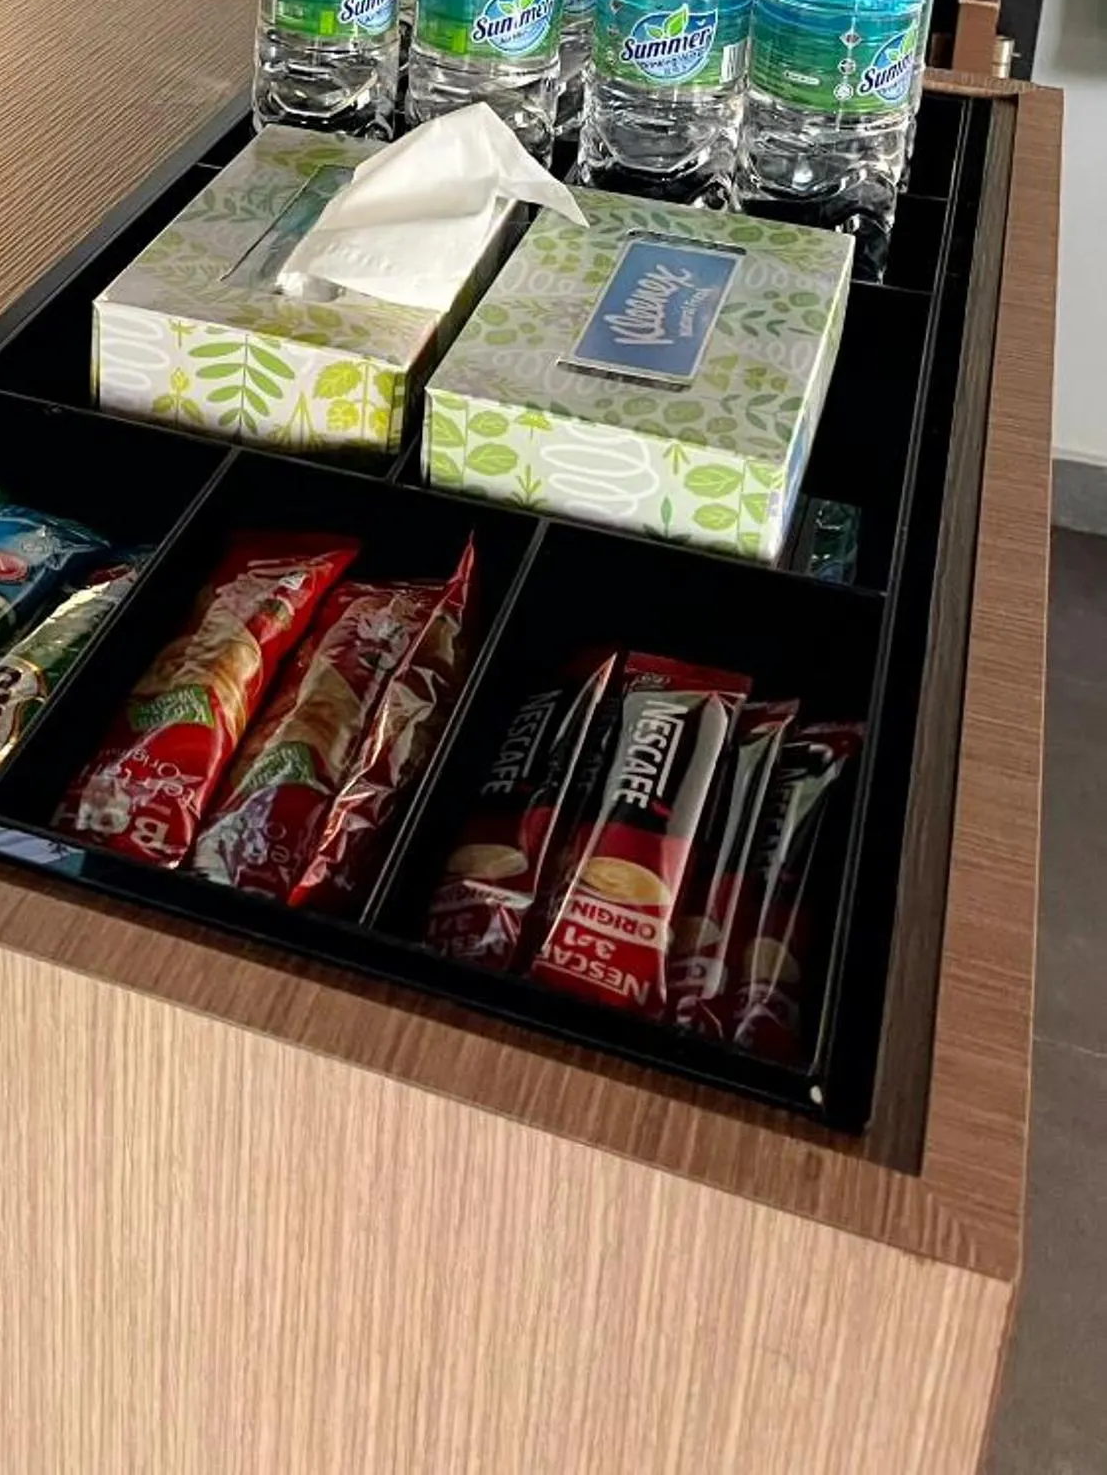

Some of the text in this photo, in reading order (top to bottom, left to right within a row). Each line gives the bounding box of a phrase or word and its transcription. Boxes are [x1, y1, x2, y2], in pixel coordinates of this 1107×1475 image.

[620, 27, 712, 62] Summer
[859, 53, 912, 94] Summe
[603, 263, 694, 345] Kleenex
